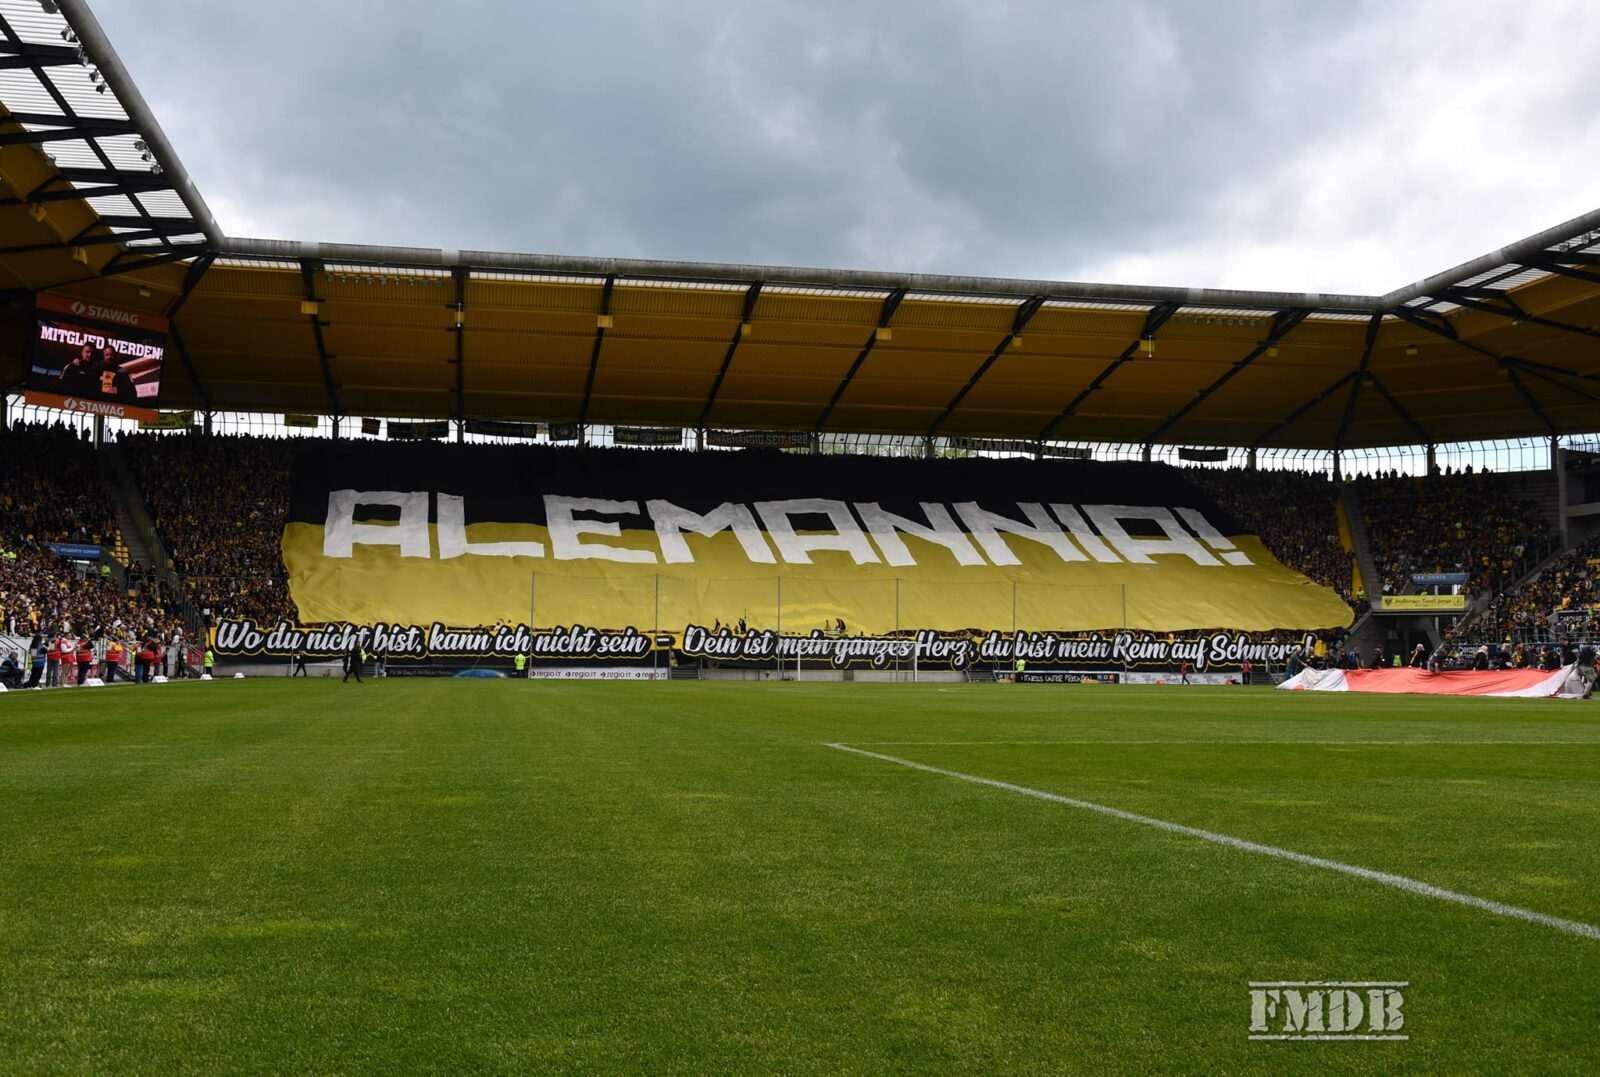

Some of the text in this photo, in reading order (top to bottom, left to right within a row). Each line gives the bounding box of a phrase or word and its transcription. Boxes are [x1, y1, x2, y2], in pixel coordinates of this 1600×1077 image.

[87, 305, 138, 325] STAWAG
[40, 326, 104, 350] MITGLIED
[79, 401, 124, 417] STAWAG
[951, 437, 1026, 452] ALEMANNIA
[322, 489, 1255, 566] ALEMANNIA!
[217, 621, 263, 649] Wo
[267, 622, 302, 649] du
[306, 624, 370, 650] nicht
[373, 624, 422, 653] bist,
[429, 624, 494, 651] kann
[495, 625, 535, 651] ich
[536, 624, 601, 653] nicht
[600, 628, 647, 653] sein
[687, 627, 741, 652] Dein
[744, 628, 774, 653] ist
[777, 630, 833, 656] mein
[834, 640, 914, 664] ganzes
[916, 631, 975, 665] Herz,
[981, 633, 1015, 657] du
[1015, 632, 1056, 658] bist
[1058, 635, 1112, 658] mein
[1113, 634, 1169, 661] Reim
[1171, 639, 1208, 668] auf
[607, 671, 625, 679] regio
